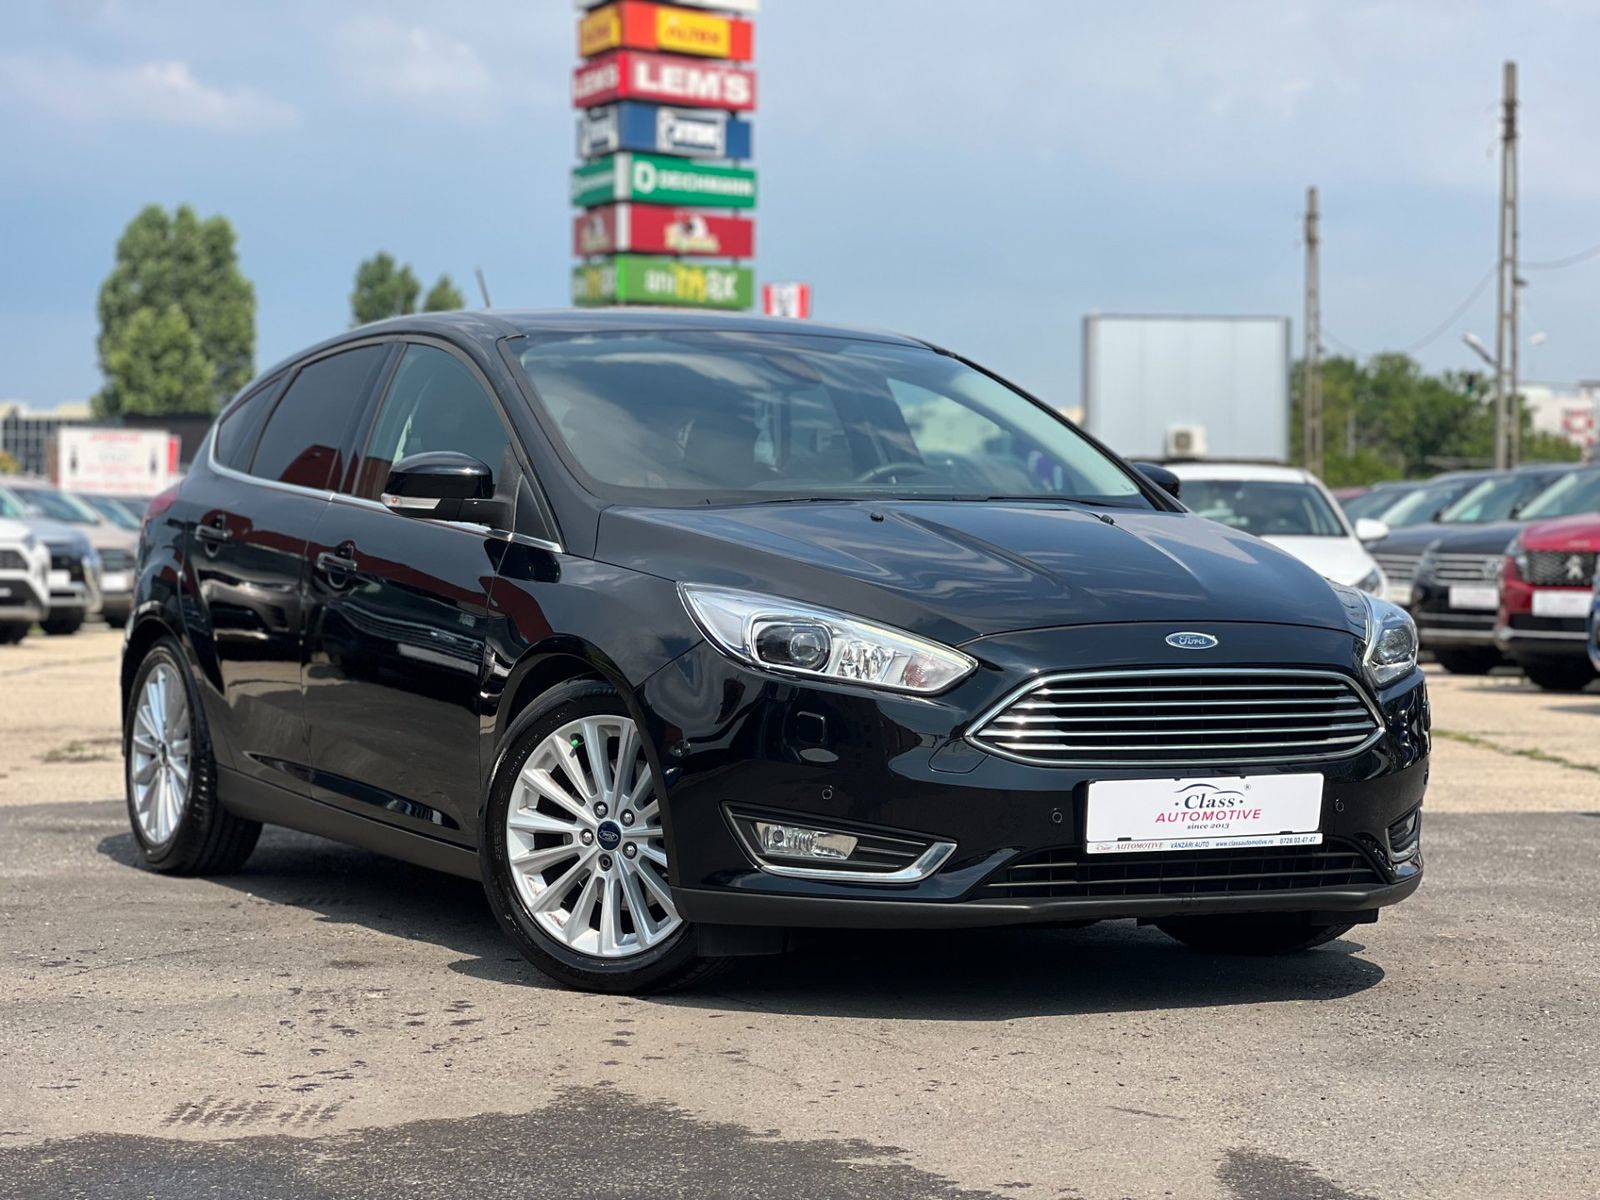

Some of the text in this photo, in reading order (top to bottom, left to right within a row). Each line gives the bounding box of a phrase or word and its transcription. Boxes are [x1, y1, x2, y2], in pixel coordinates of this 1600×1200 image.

[634, 61, 751, 104] LEM'S
[1178, 635, 1207, 645] Ford
[1184, 793, 1236, 810] Class
[1155, 808, 1263, 823] AUTOMOTIVE
[1210, 822, 1230, 830] 2013
[1115, 841, 1164, 850] AUTOMOTIVE
